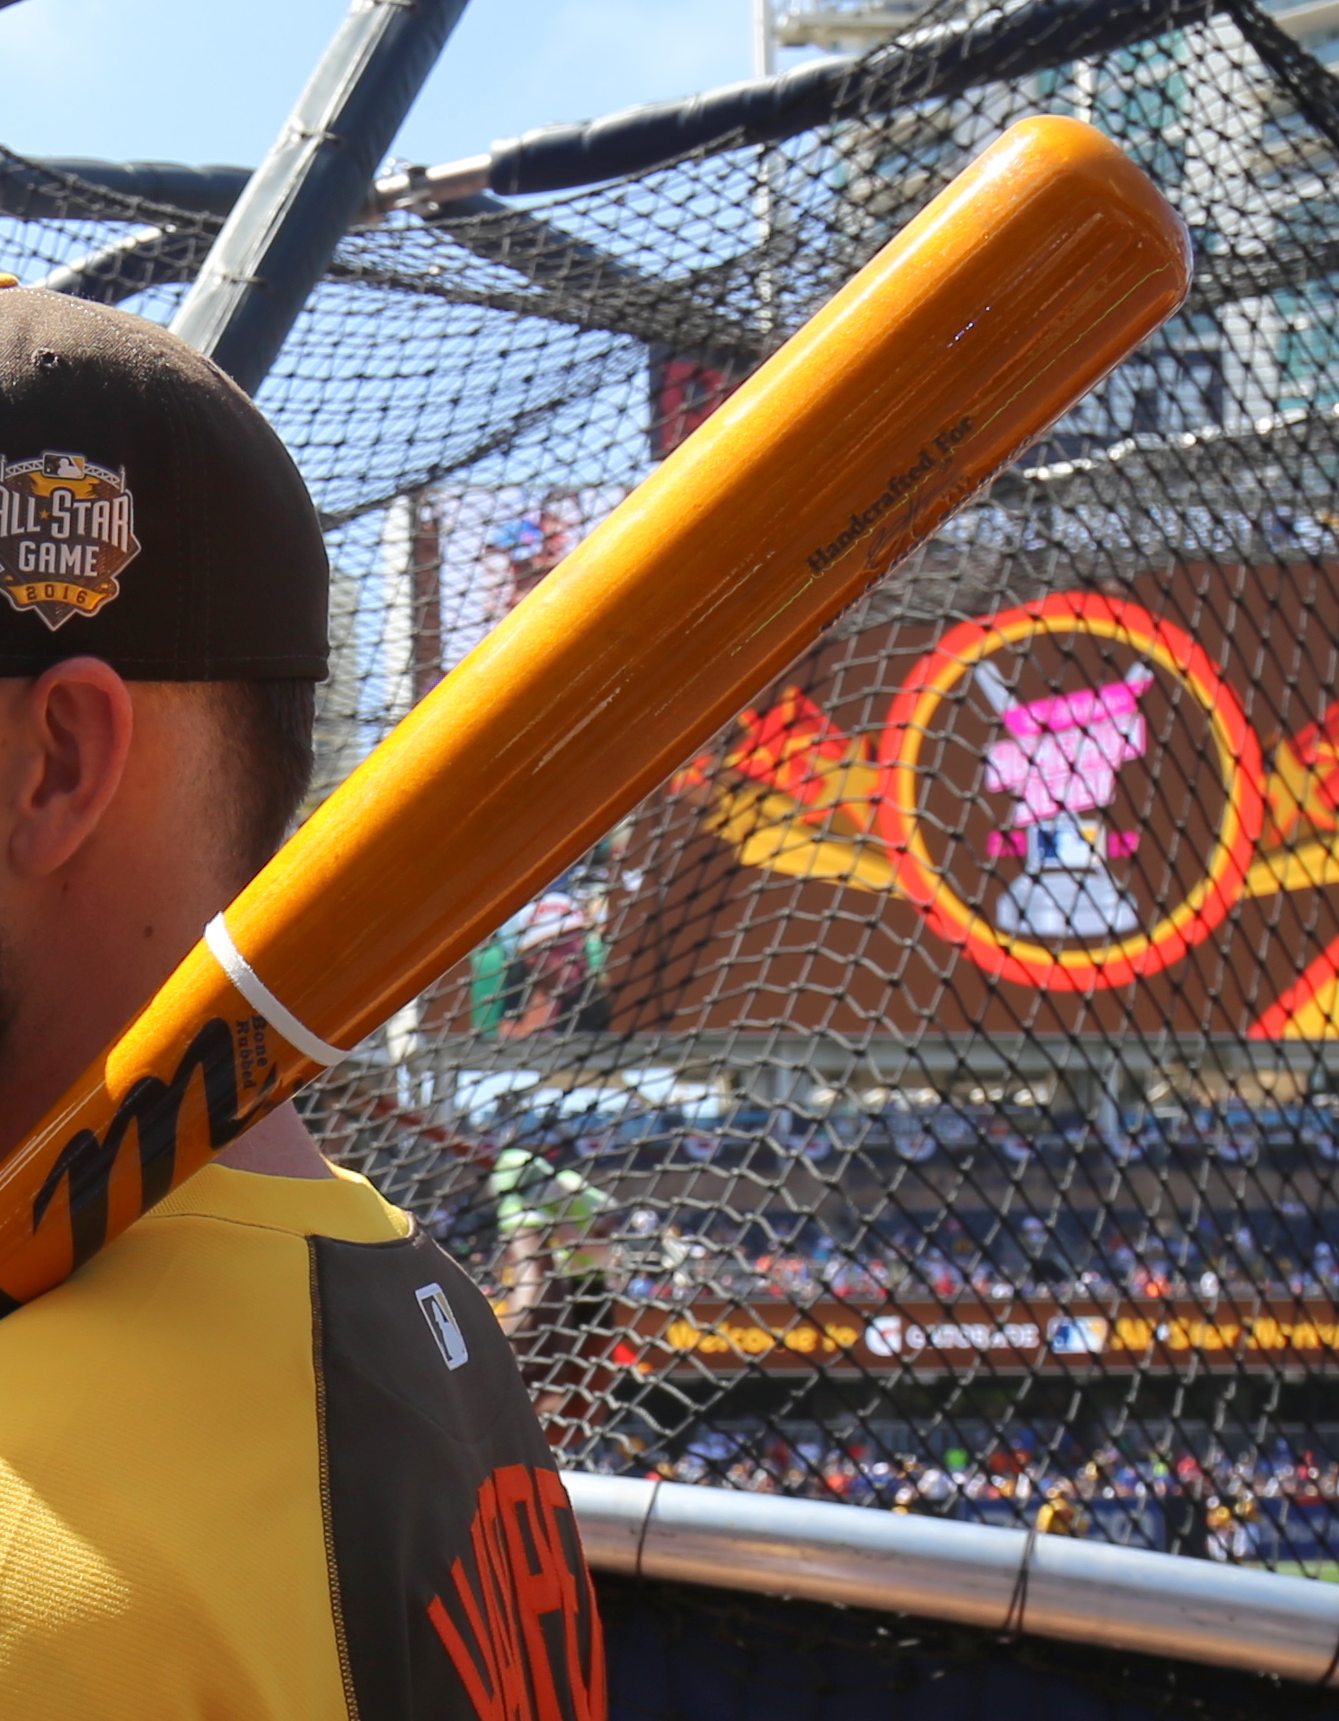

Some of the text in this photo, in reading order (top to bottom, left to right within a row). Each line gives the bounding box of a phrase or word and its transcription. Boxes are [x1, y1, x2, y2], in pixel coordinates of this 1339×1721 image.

[50, 489, 130, 554] STAR
[806, 450, 936, 573] Handcrafted
[932, 414, 973, 454] For
[18, 540, 101, 578] GAME
[25, 585, 88, 605] 2016
[236, 1020, 258, 1089] Rubbed
